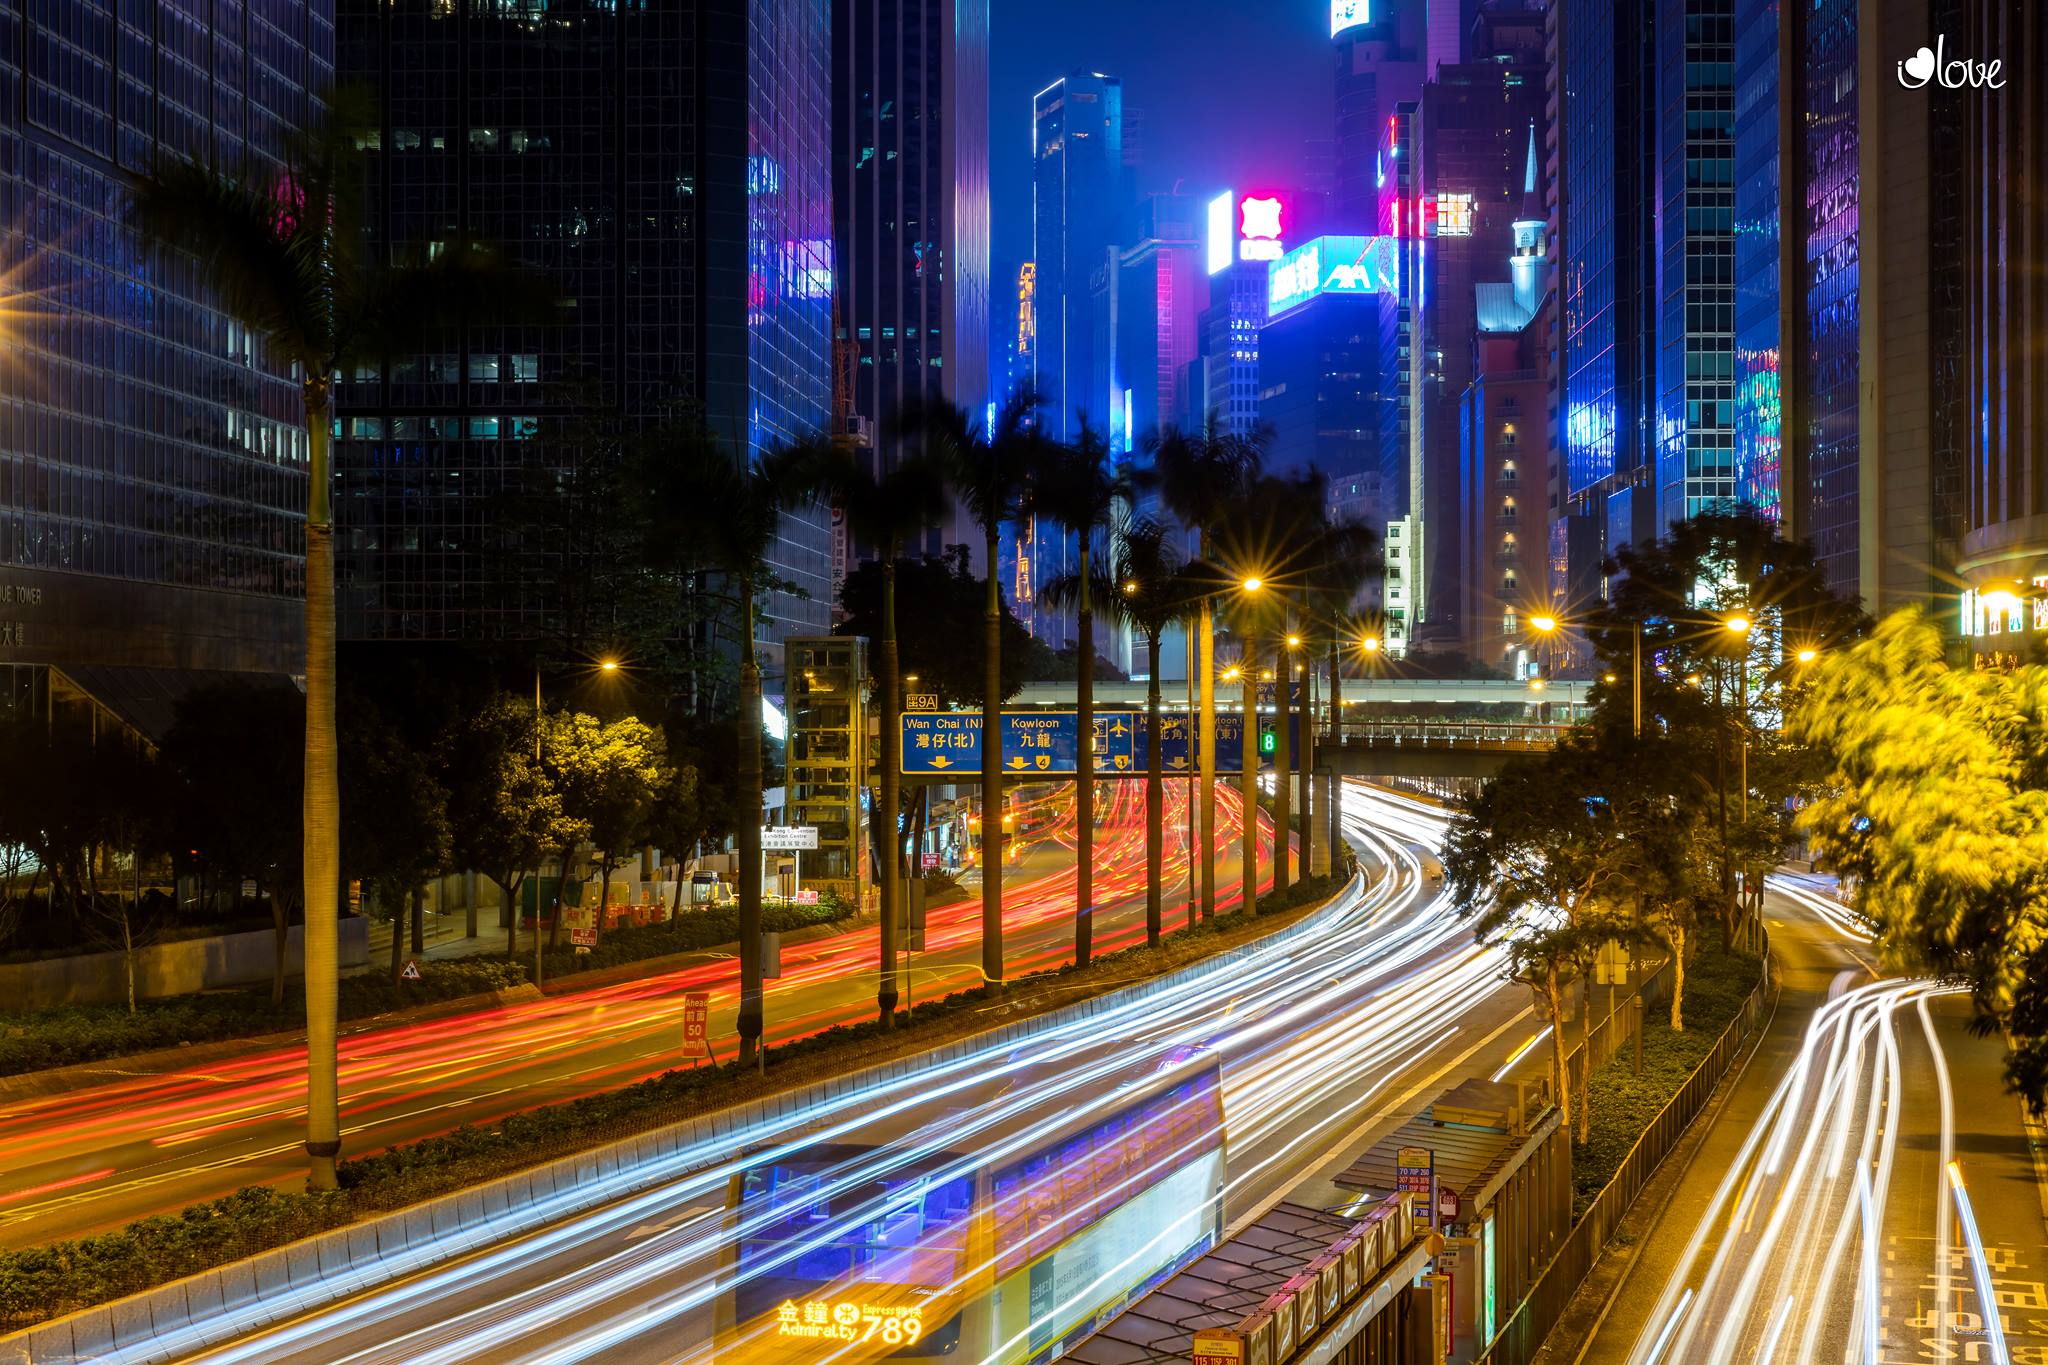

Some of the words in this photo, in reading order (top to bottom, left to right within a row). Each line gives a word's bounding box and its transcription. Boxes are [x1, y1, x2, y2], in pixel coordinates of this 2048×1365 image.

[1323, 264, 1371, 288] AXA
[0, 585, 12, 602] UE
[16, 586, 41, 605] TOWER
[918, 696, 936, 708] 9A
[906, 719, 930, 729] Wan
[936, 718, 960, 729] Chai
[965, 718, 983, 729] (N)
[1011, 718, 1059, 728] Kowloon
[915, 733, 975, 748] 灣仔(北)
[1020, 733, 1051, 748] 九龍
[1265, 734, 1275, 750] 8
[1039, 758, 1046, 767] 4
[686, 999, 708, 1007] Ahead
[688, 1024, 702, 1036] 50
[684, 1038, 707, 1049] km/h
[776, 1299, 829, 1323] 金鐘
[862, 1303, 895, 1315] Express
[778, 1321, 858, 1341] Admiralty
[862, 1315, 922, 1345] 789
